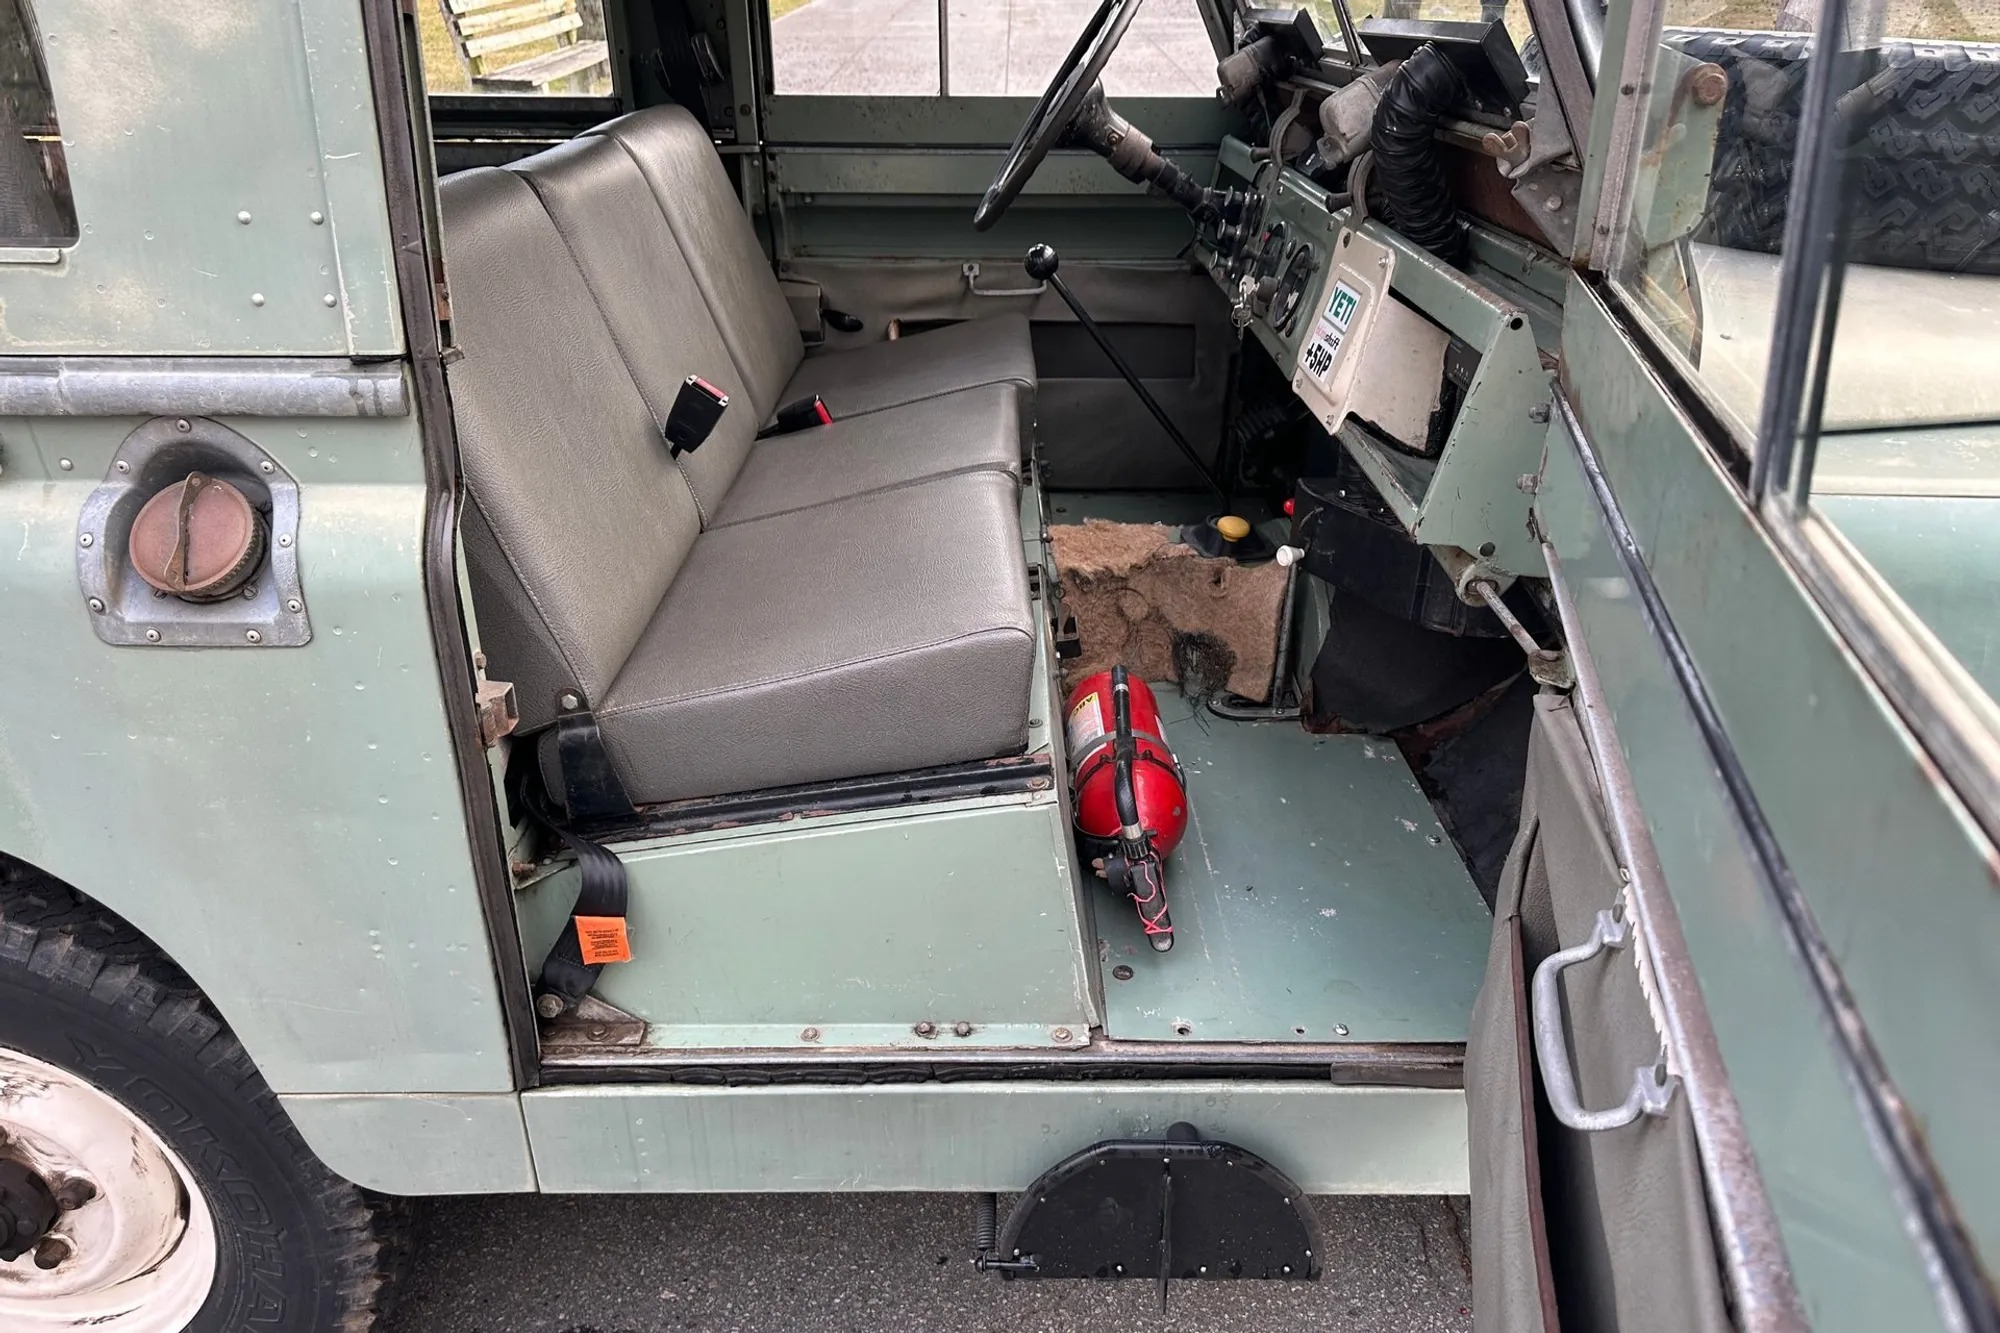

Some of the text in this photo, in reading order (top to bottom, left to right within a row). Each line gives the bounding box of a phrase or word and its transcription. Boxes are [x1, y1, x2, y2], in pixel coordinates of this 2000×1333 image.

[1328, 286, 1357, 325] YETI
[1304, 343, 1332, 378] +5HP
[64, 1030, 286, 1333] YOKOHA
